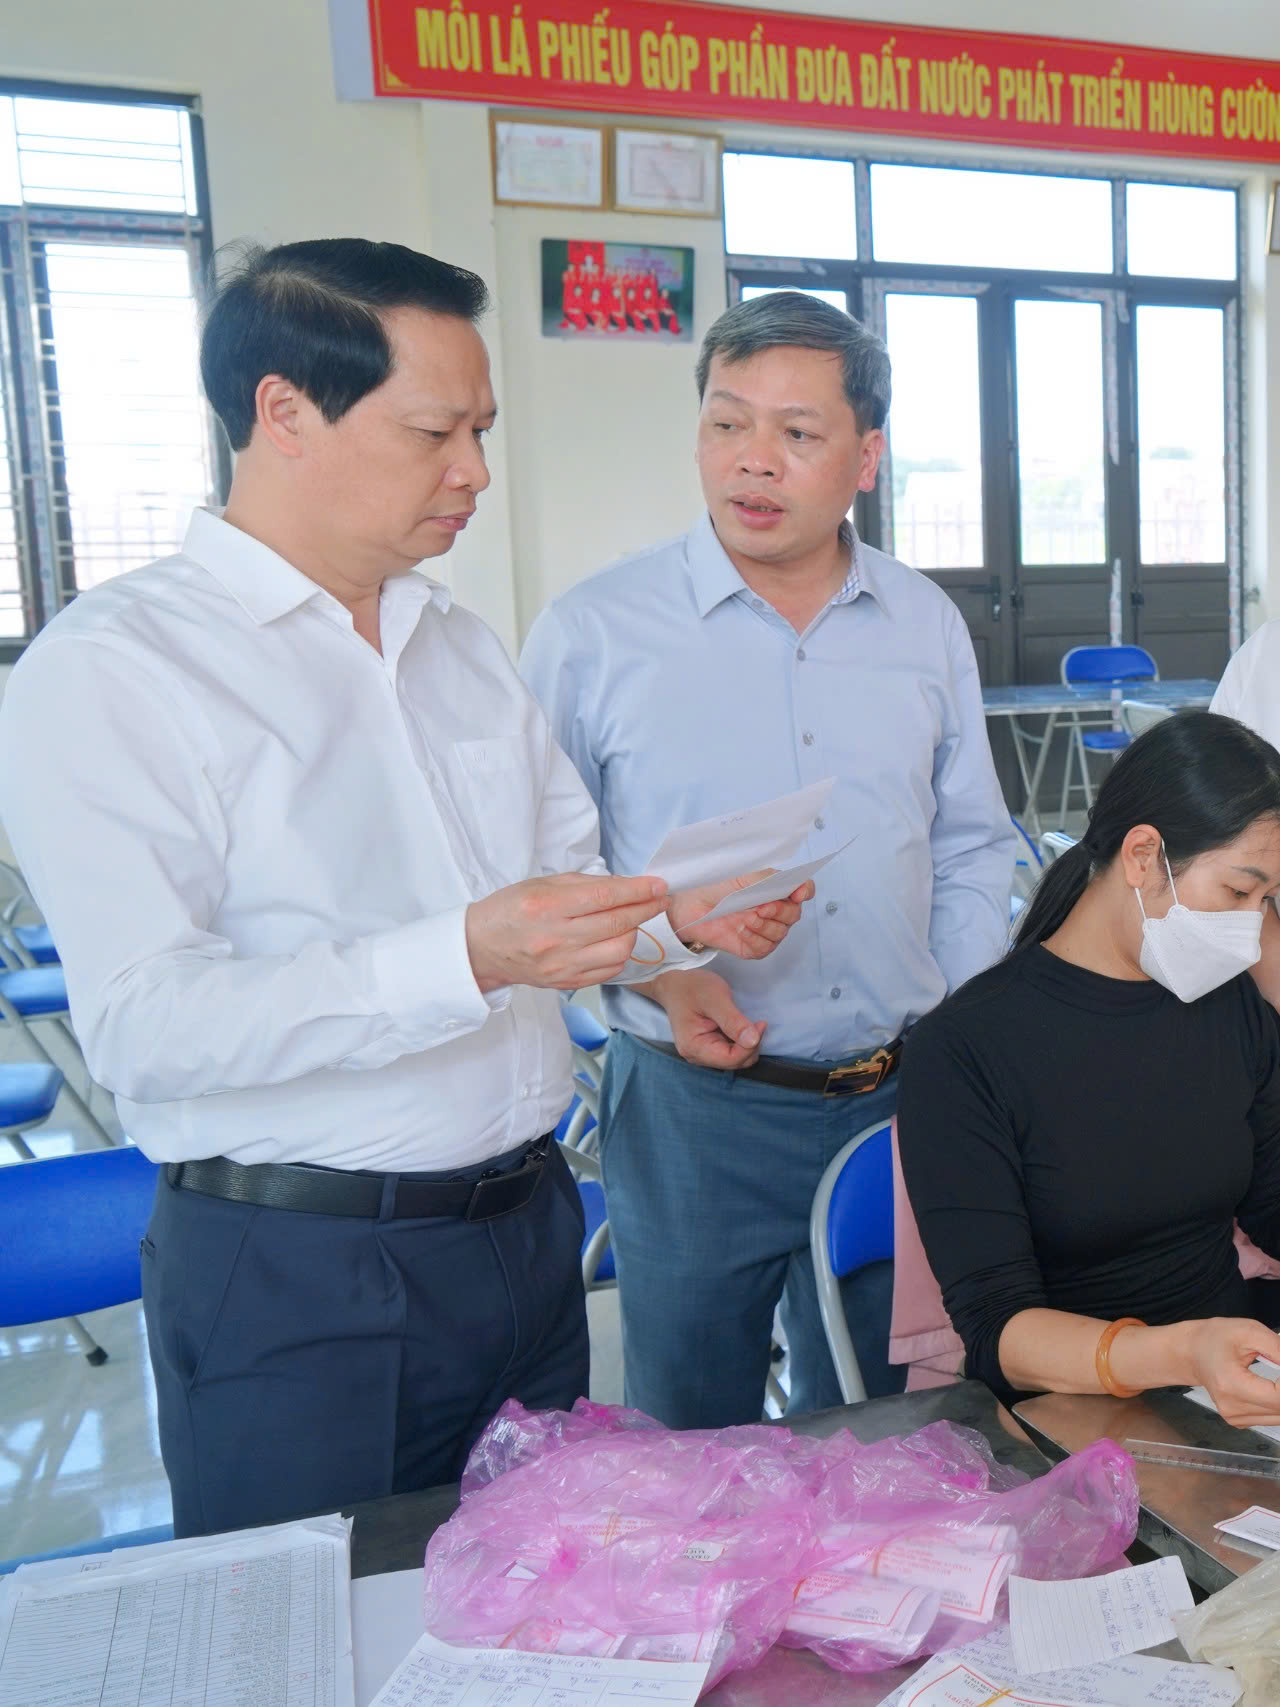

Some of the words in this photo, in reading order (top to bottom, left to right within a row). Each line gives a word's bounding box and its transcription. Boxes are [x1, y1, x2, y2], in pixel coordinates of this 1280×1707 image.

[489, 4, 531, 77] LÁ
[538, 8, 631, 87] PHIẾU
[640, 21, 700, 92] GÓP
[708, 23, 789, 101] PHẦN
[796, 44, 853, 106] ĐƯA
[860, 37, 912, 112] ĐẤT
[918, 52, 991, 119] NƯỚC
[998, 60, 1063, 125] PHÁT
[1069, 57, 1141, 132] TRIỂN
[1148, 71, 1214, 137] HÙNG
